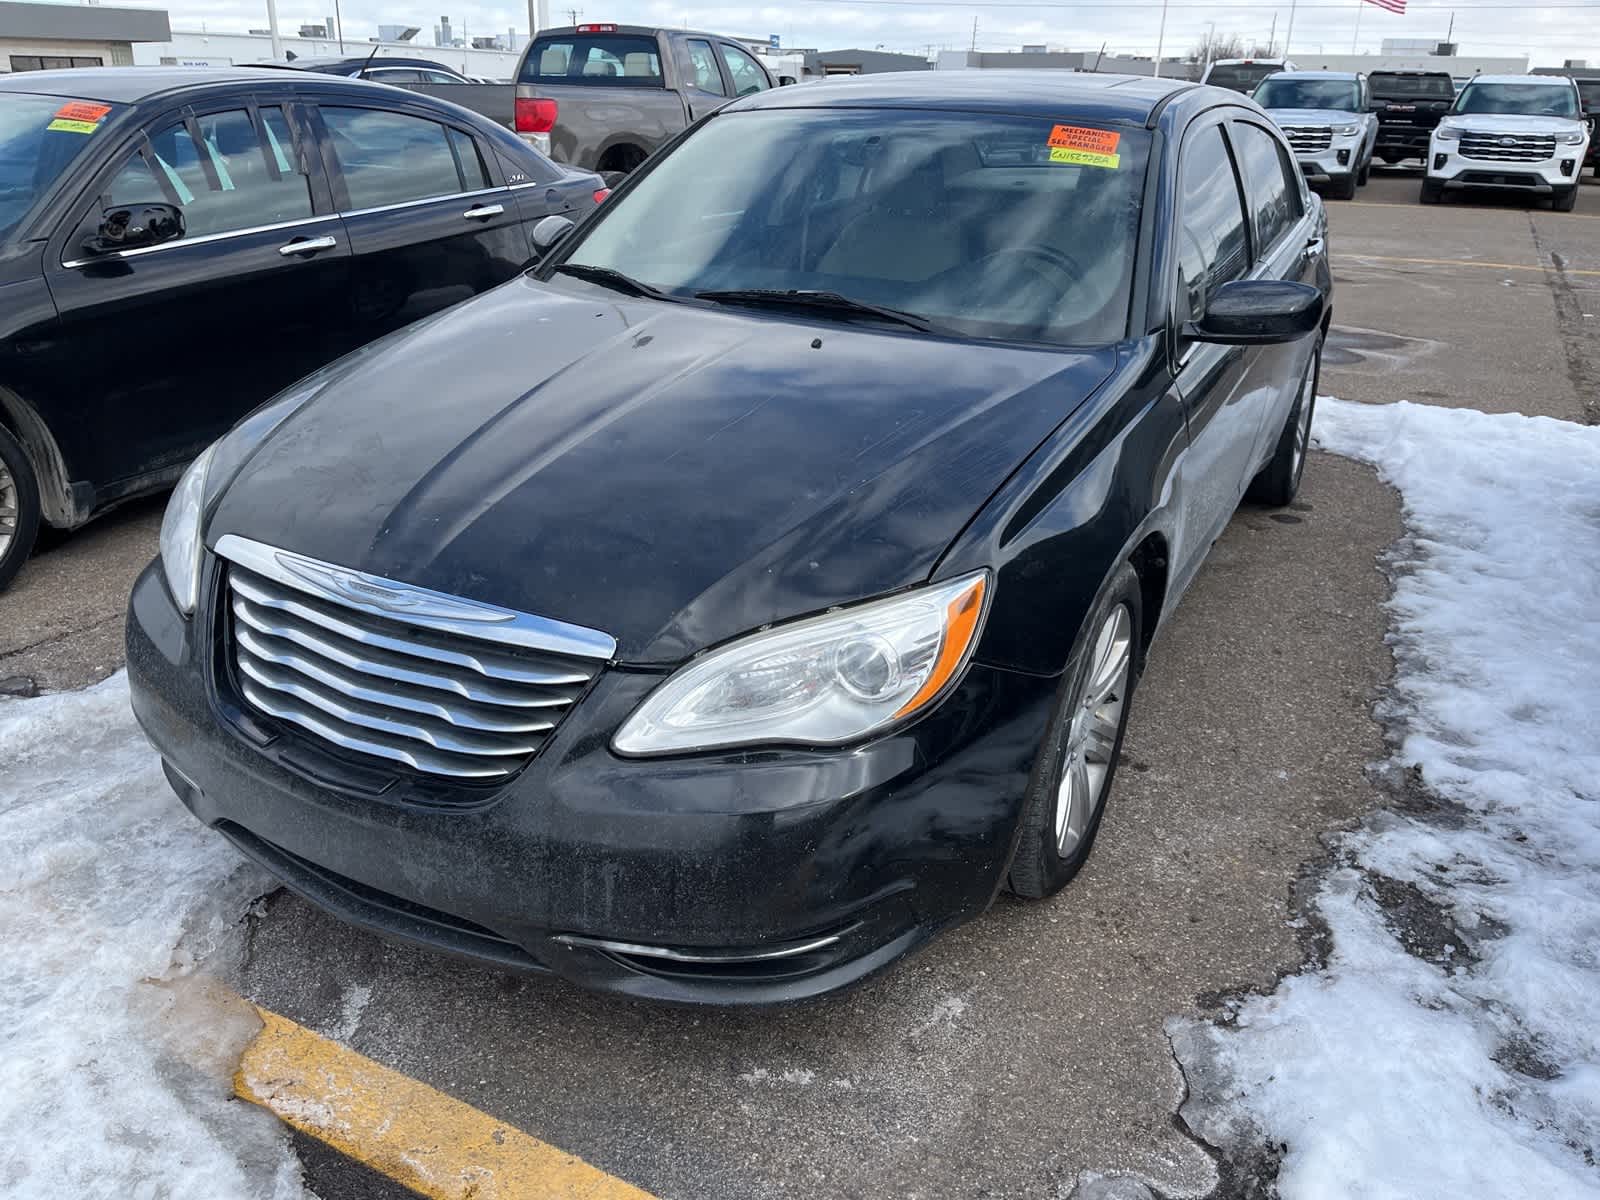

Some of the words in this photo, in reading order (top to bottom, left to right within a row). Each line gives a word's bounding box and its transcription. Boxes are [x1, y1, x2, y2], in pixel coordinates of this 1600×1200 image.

[1061, 127, 1112, 139] MECHANICS
[1067, 134, 1103, 143] SPECIAL
[1069, 140, 1113, 152] MANAGER
